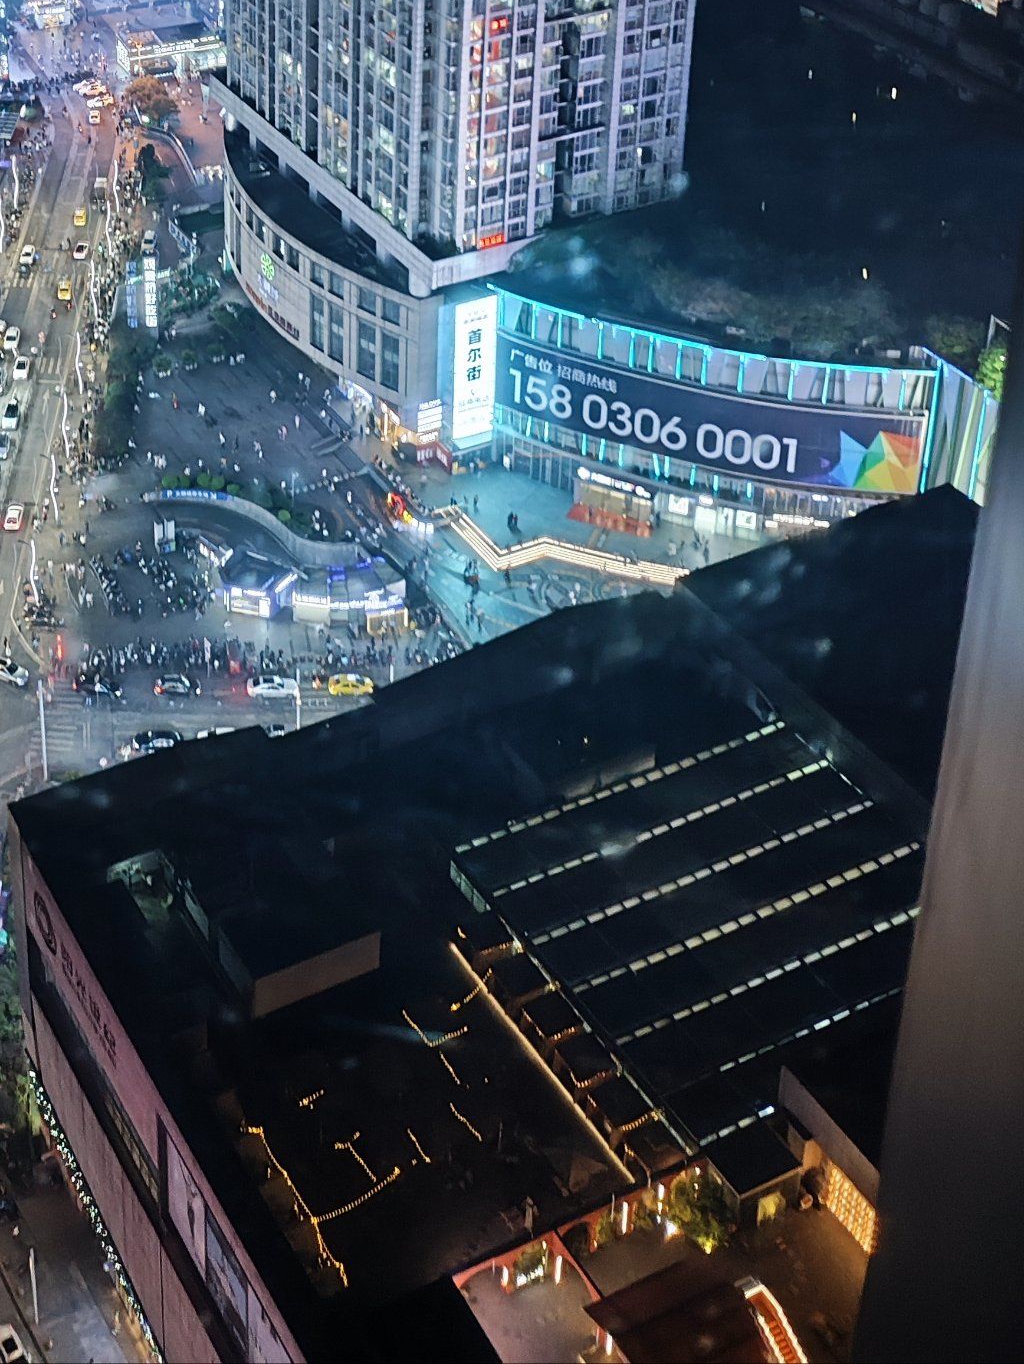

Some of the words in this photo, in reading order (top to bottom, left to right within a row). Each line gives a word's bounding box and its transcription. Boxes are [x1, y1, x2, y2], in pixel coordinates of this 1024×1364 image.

[466, 328, 483, 382] 首尔街
[510, 348, 553, 375] 广告位
[557, 363, 618, 394] 招商热线
[509, 367, 573, 420] 158
[581, 392, 688, 452] 0306
[695, 422, 797, 474] 0001
